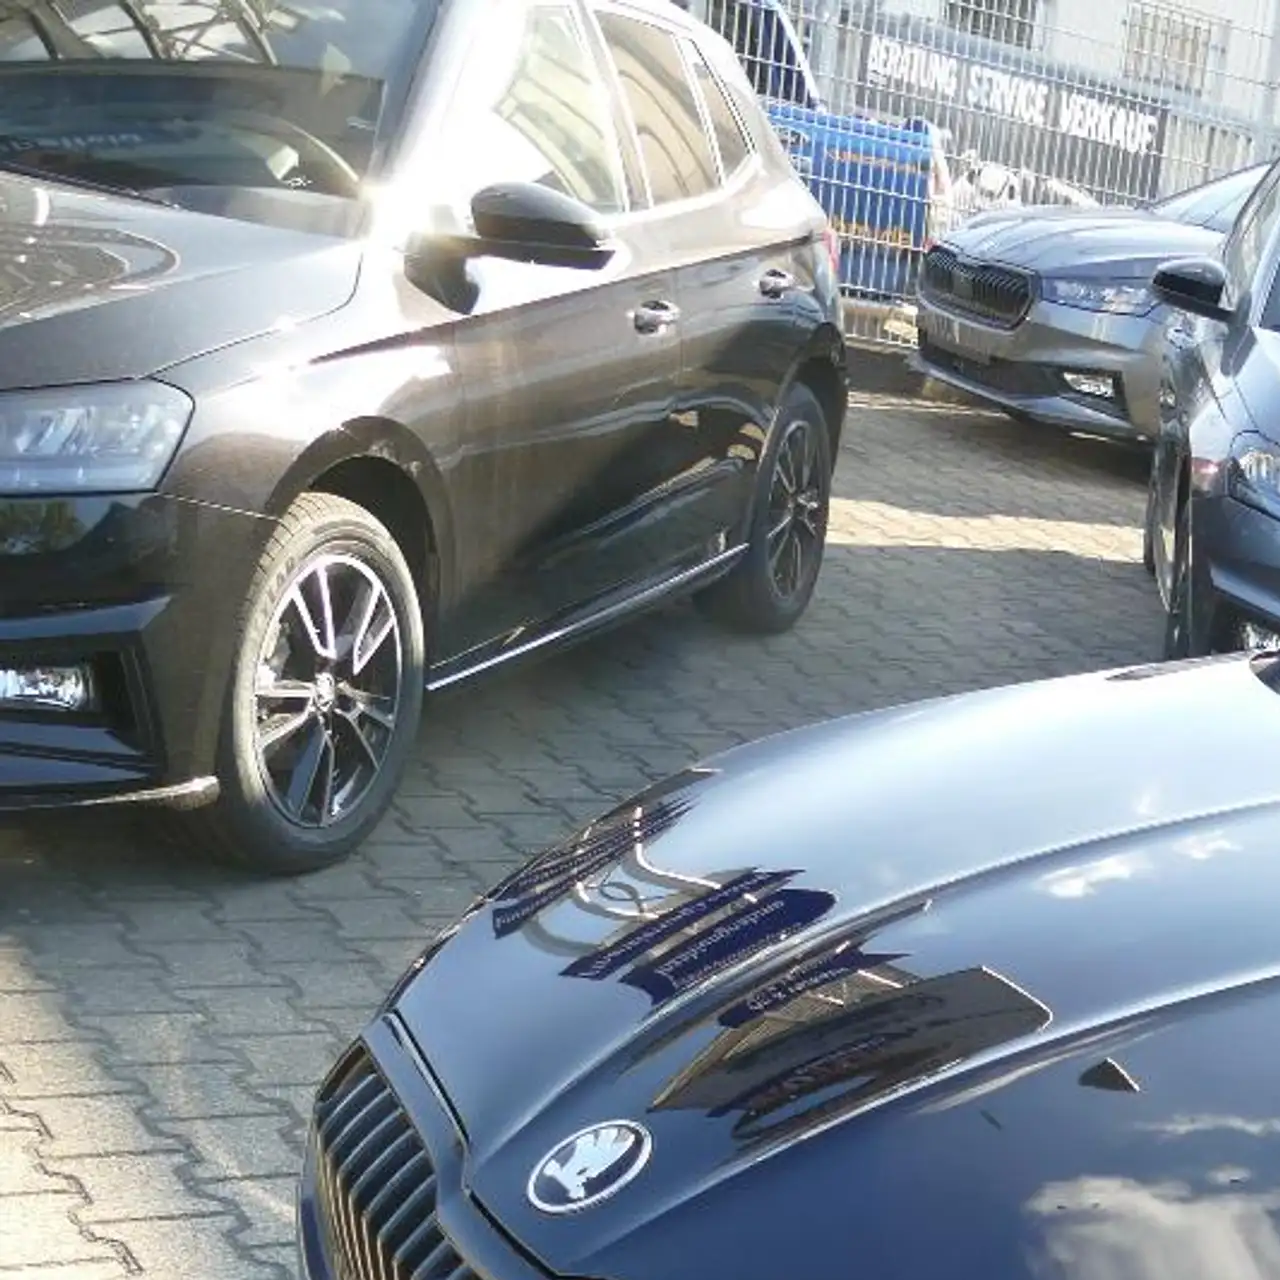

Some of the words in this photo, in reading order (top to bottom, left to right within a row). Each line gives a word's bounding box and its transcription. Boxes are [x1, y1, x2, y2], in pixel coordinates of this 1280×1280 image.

[868, 38, 957, 96] BERATUNG
[968, 65, 1048, 124] SERVICE
[1059, 91, 1158, 152] VERKAUF
